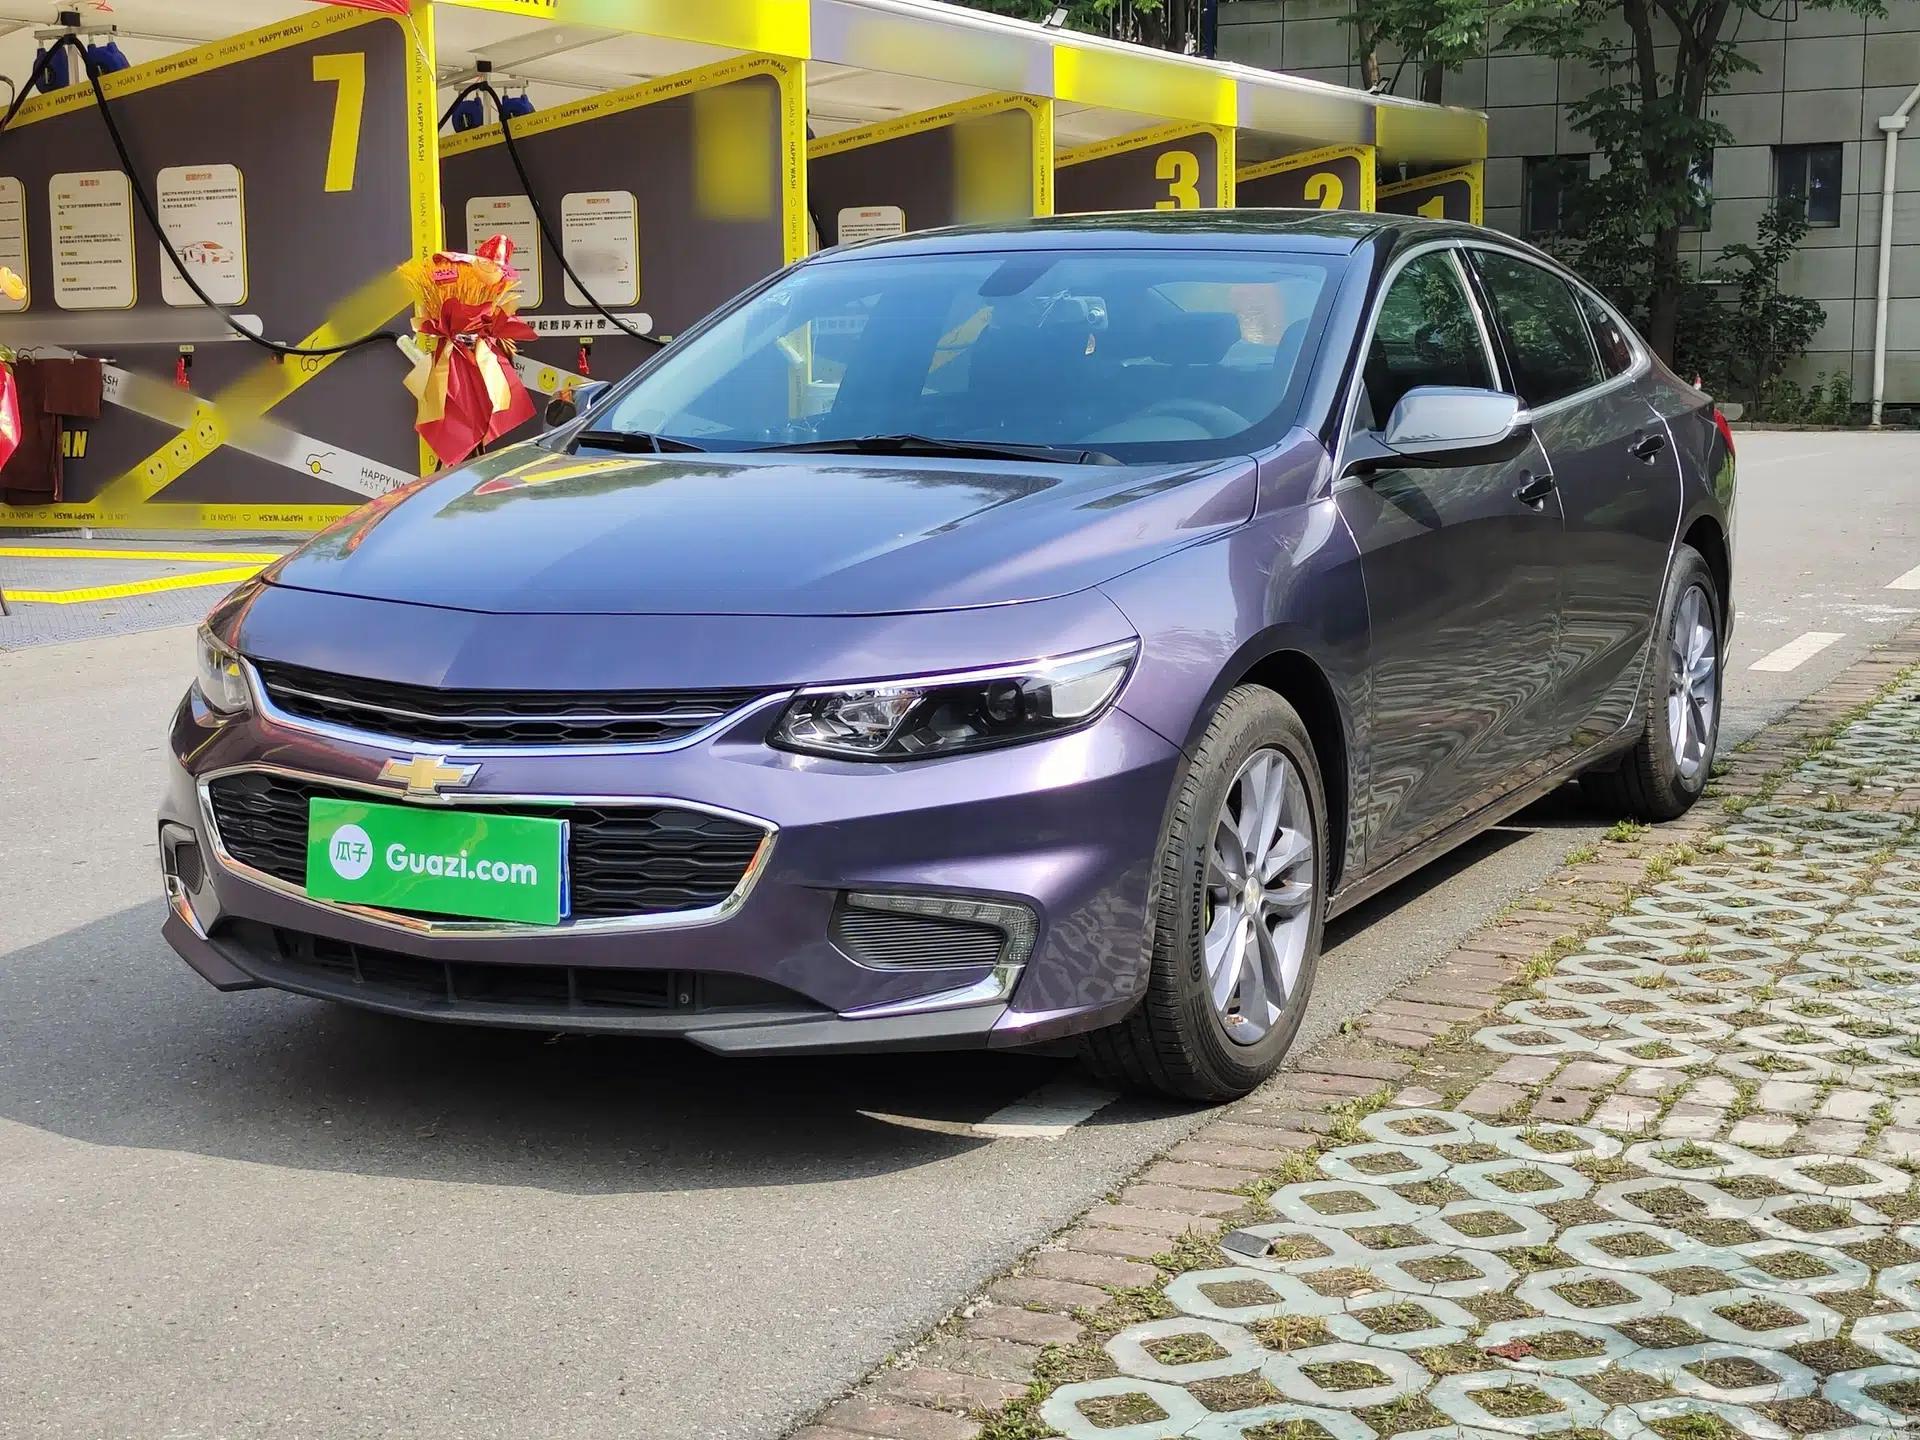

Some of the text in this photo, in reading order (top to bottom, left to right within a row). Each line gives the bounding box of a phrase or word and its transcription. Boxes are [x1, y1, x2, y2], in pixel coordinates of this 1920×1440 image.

[18, 105, 37, 117] HUAN
[55, 93, 76, 105] HAPPY
[117, 76, 136, 87] HUAN
[155, 63, 177, 75] HAPPY
[219, 44, 239, 56] HUAN
[258, 32, 281, 45] HAPPY
[282, 25, 304, 38] WASH
[326, 12, 346, 24] HUAN
[472, 130, 490, 141] HAPPY
[560, 108, 580, 119] HAPPY
[581, 103, 599, 113] WASH
[653, 83, 674, 94] HAPPY
[675, 78, 692, 88] WASH
[748, 58, 770, 69] HAPPY
[771, 59, 788, 75] WASH
[313, 52, 365, 192] 7
[417, 102, 425, 135] HAPPY
[838, 135, 856, 145] HAPPY
[920, 115, 937, 124] HAPPY
[1003, 95, 1022, 105] HAPPY
[1155, 151, 1200, 209] 3
[1304, 173, 1344, 211] 2
[103, 373, 118, 386] ASH
[62, 431, 87, 457] AN
[361, 467, 391, 484] HAPPY
[54, 512, 73, 520] WASH
[75, 512, 96, 520] HAPPY
[280, 514, 304, 522] HAPPY
[1190, 860, 1205, 983] Continental
